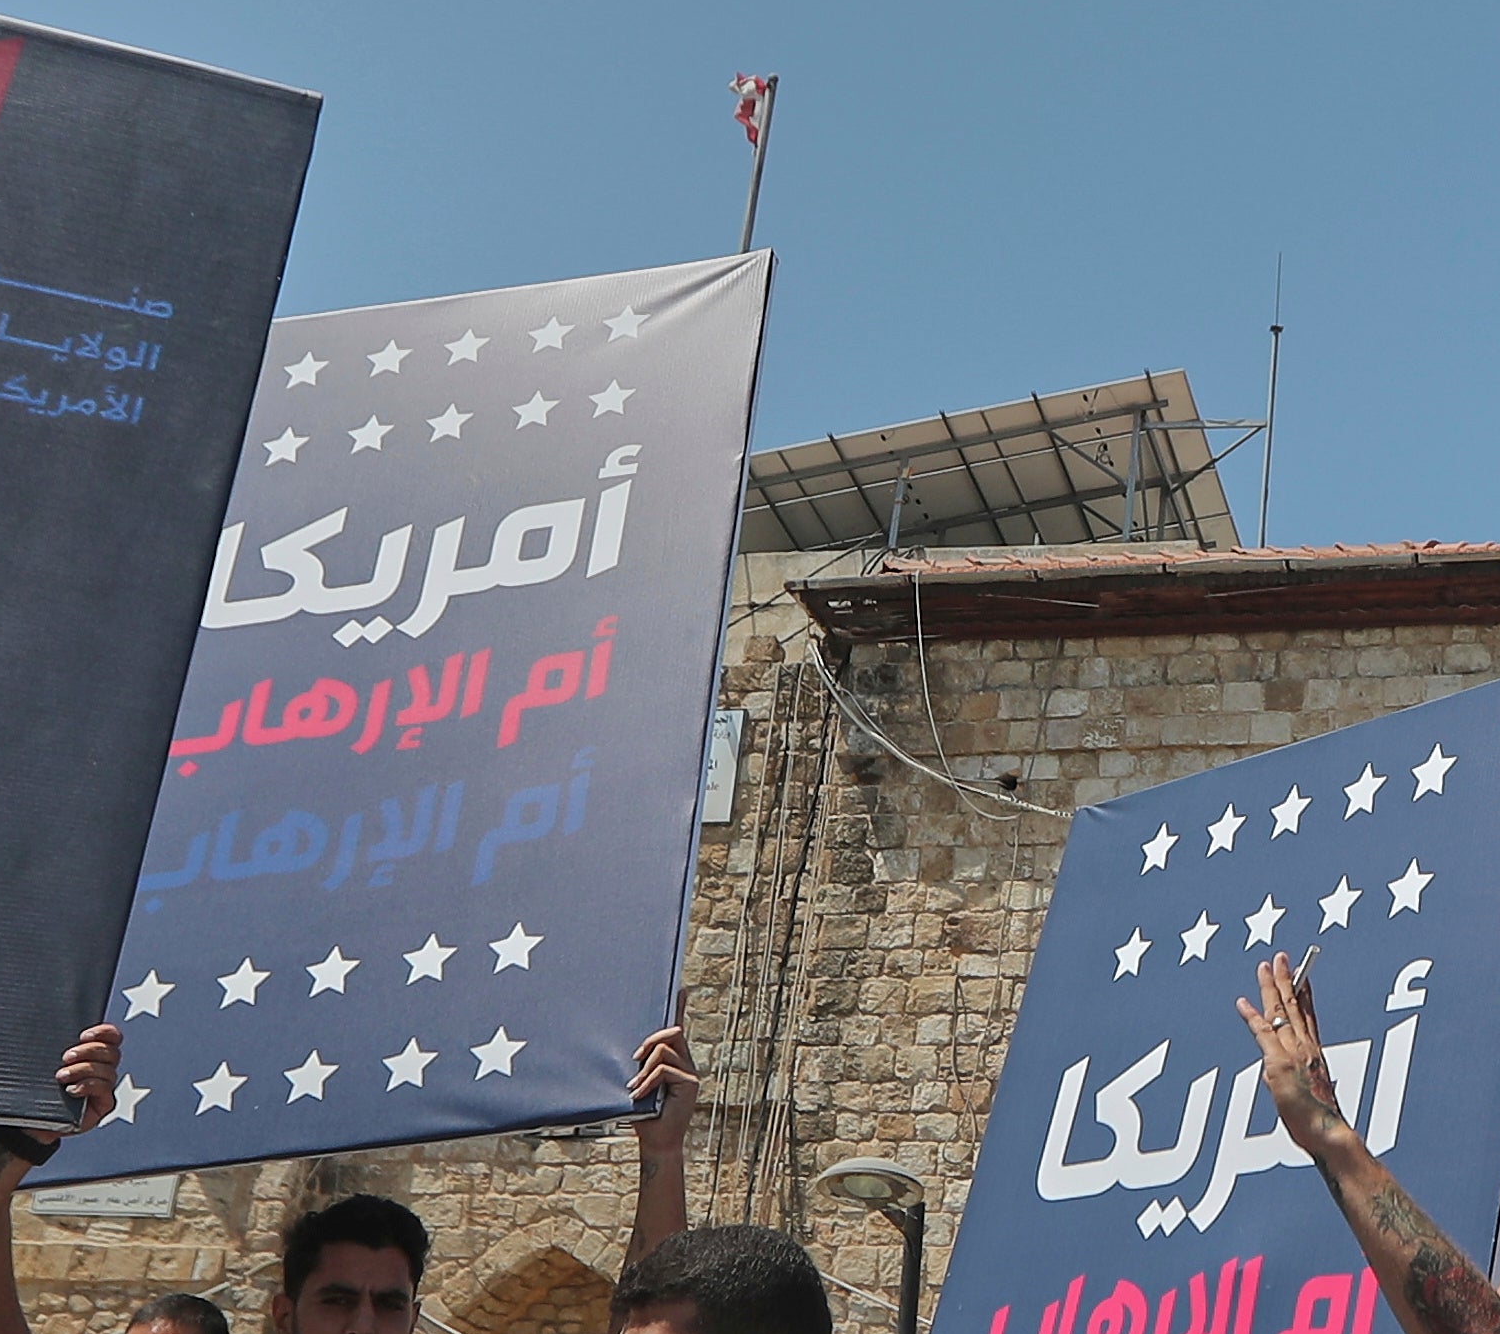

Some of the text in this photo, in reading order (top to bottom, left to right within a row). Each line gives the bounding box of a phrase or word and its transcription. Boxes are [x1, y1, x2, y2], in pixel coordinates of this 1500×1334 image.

[199, 443, 642, 648] أمريكا
[170, 615, 619, 776] أم الإرهاب
[139, 750, 596, 914] أم الإرهاب
